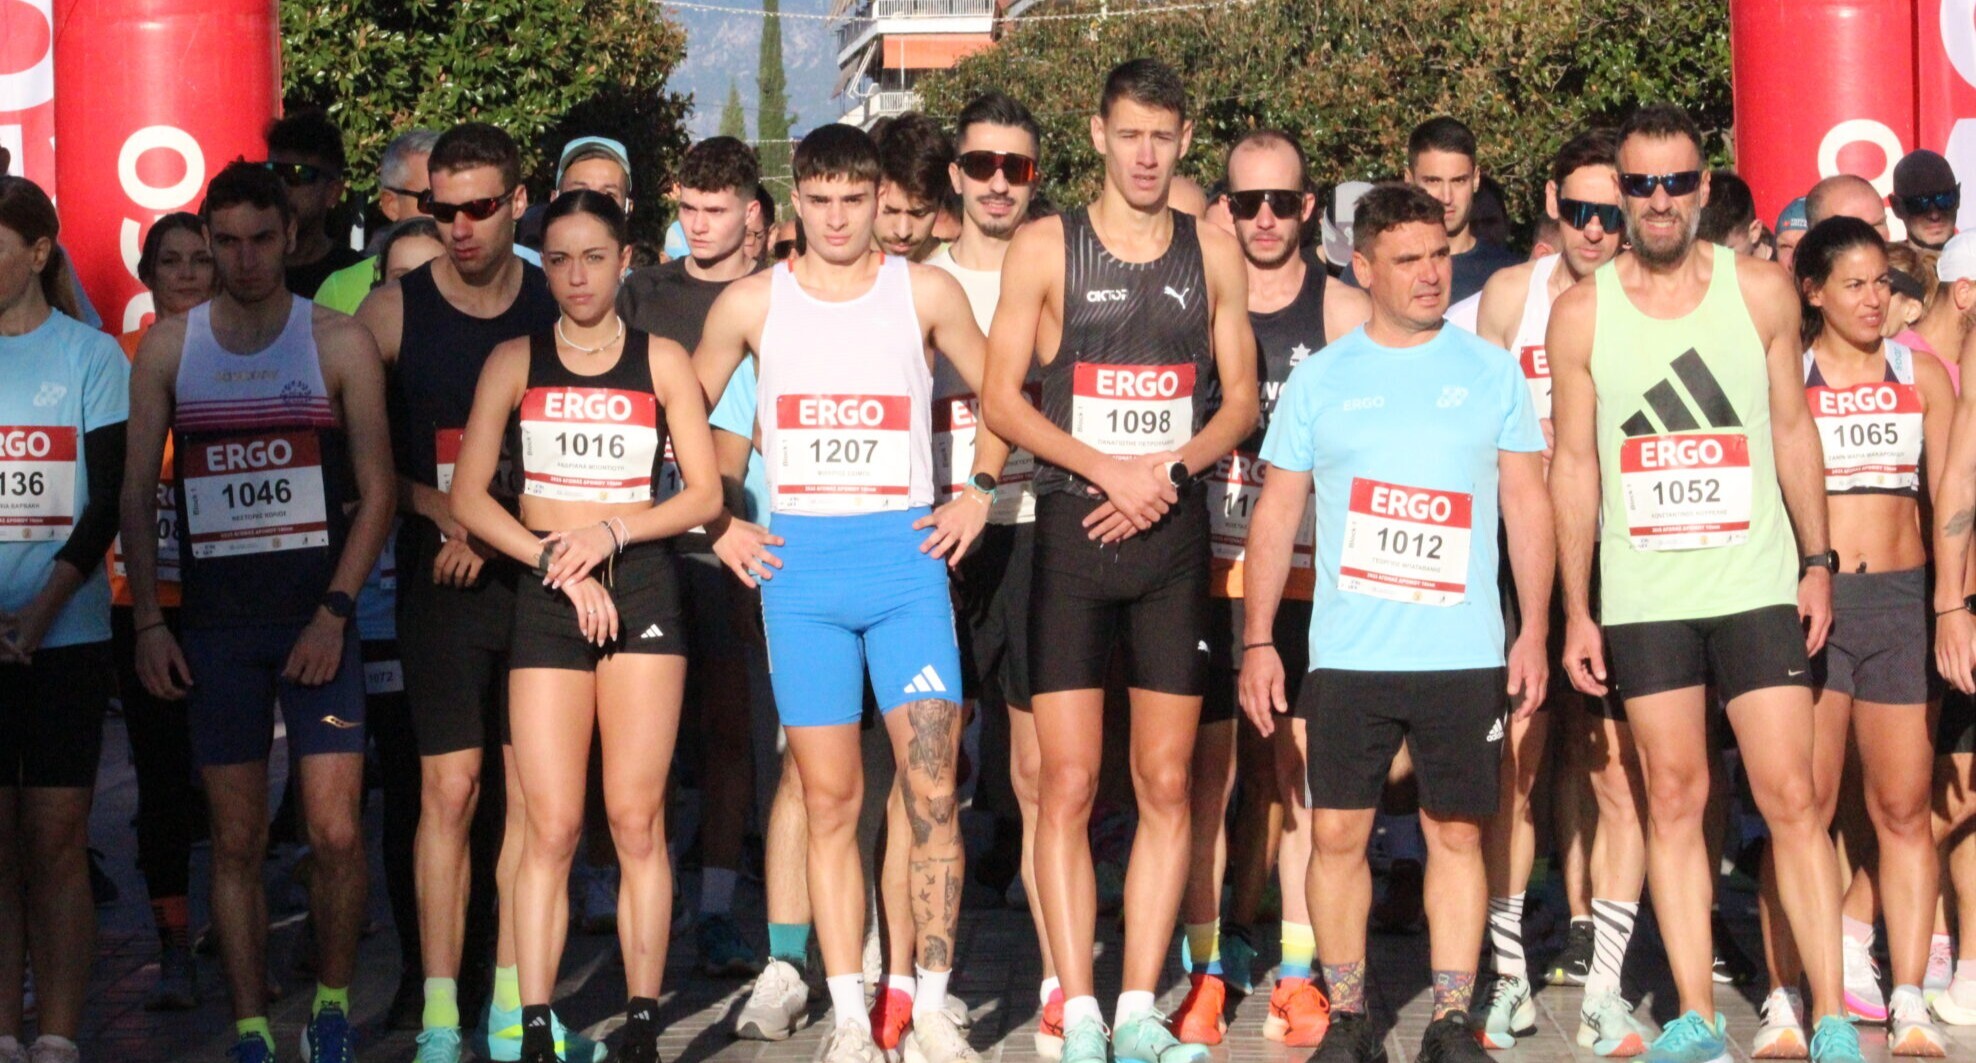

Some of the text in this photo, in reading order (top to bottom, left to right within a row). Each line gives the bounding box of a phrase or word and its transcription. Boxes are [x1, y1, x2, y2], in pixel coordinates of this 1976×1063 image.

[1096, 369, 1178, 397] ERGO
[544, 392, 632, 421] ERGO
[799, 399, 884, 426] ERGO
[1343, 396, 1385, 411] ERGO
[1819, 386, 1897, 415] ERGO
[1106, 409, 1171, 434] 1098
[1834, 422, 1898, 447] 1065
[206, 438, 293, 472] ERGO
[555, 432, 625, 459] 1016
[809, 438, 879, 463] 1207
[1641, 438, 1723, 468] ERGO
[1214, 455, 1267, 484] ERG
[222, 478, 292, 509] 1046
[1370, 486, 1452, 523] ERGO
[1653, 478, 1721, 505] 1052
[1377, 527, 1443, 560] 1012
